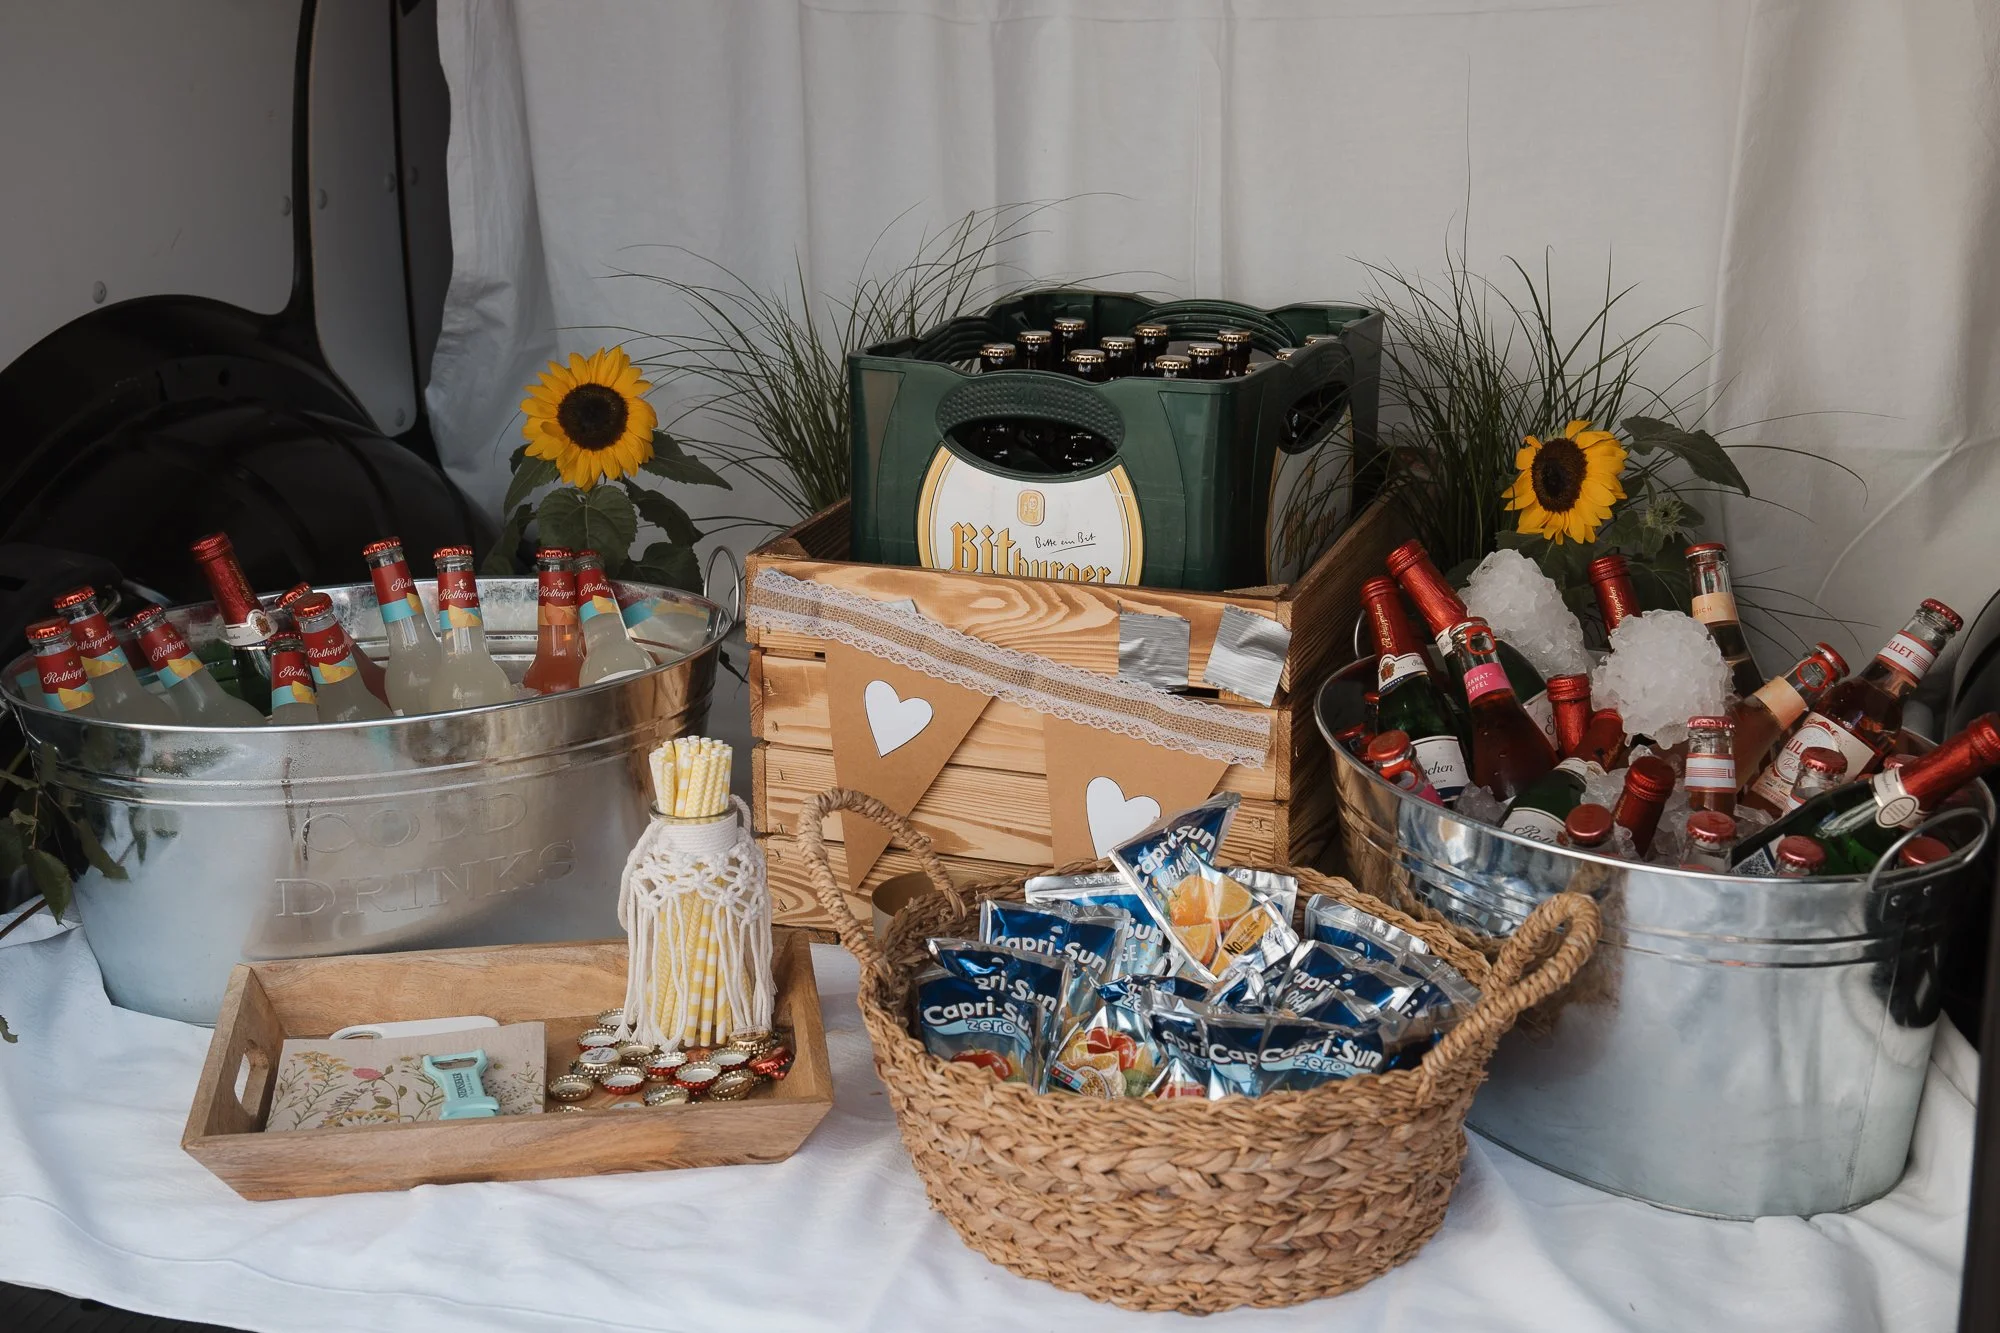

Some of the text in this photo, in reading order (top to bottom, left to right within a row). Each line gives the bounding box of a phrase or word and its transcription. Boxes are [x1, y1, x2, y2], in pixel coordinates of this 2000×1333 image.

[1035, 536, 1057, 549] Bitte
[1077, 531, 1096, 544] Bit
[300, 791, 528, 854] COLD
[274, 840, 578, 918] DRINKS
[966, 1020, 1016, 1035] zero
[1295, 1053, 1346, 1073] zero
